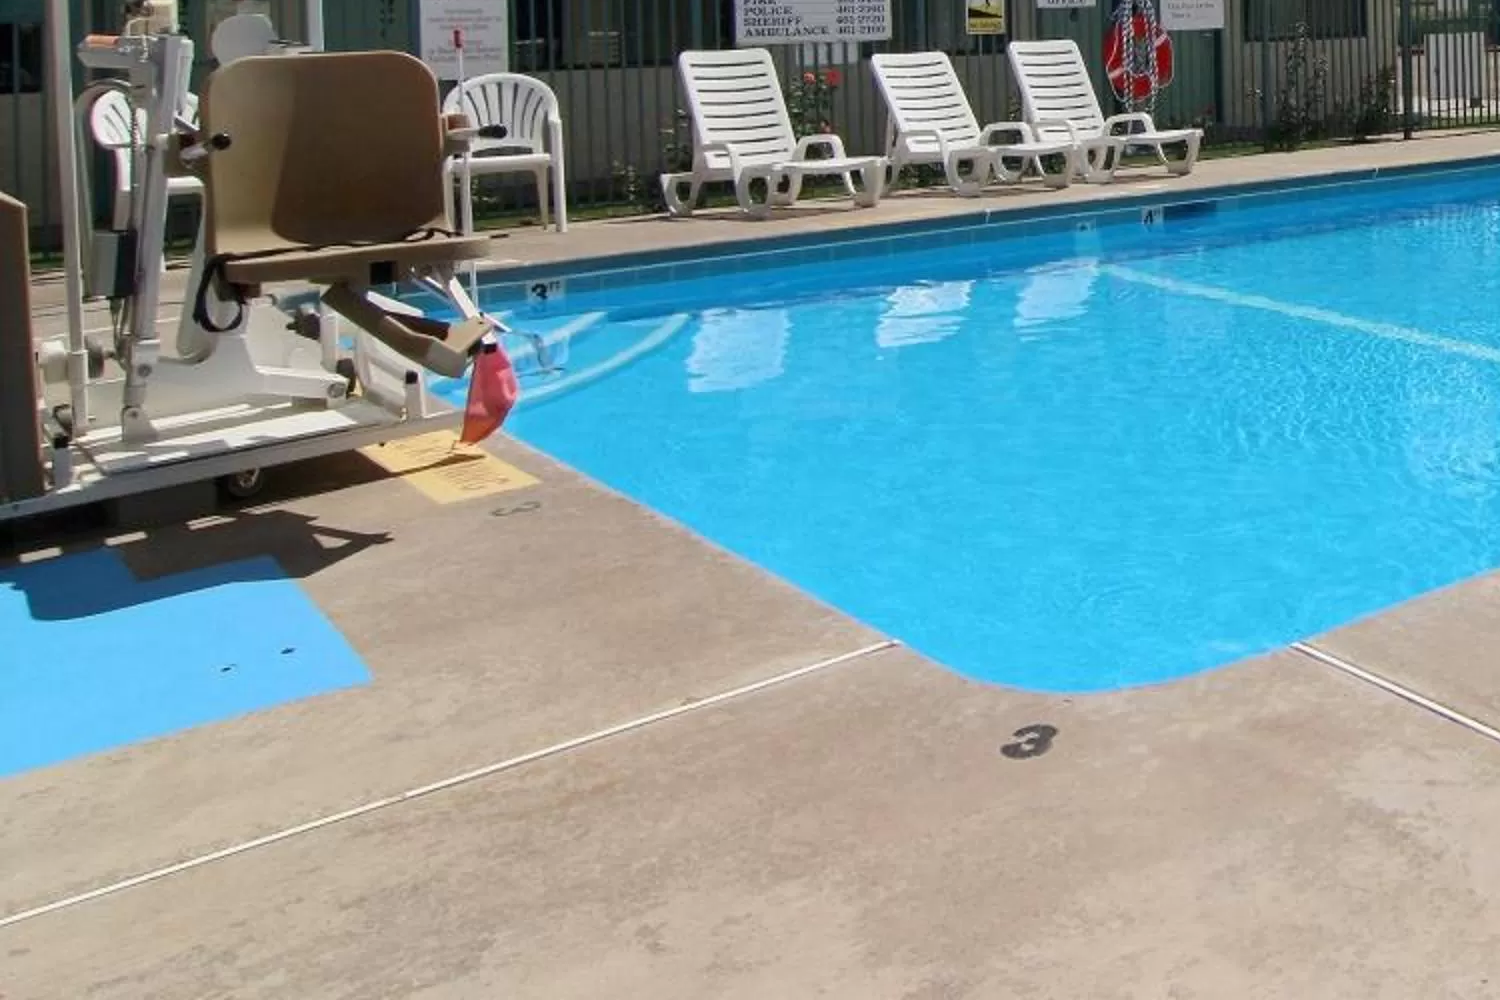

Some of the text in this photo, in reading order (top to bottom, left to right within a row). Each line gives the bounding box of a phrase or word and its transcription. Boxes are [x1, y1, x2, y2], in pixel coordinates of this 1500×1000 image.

[743, 6, 794, 17] POLICE
[743, 16, 802, 27] SHERIFF
[744, 26, 830, 37] AMBULANCE
[531, 283, 548, 300] 3
[1000, 723, 1059, 761] 3
